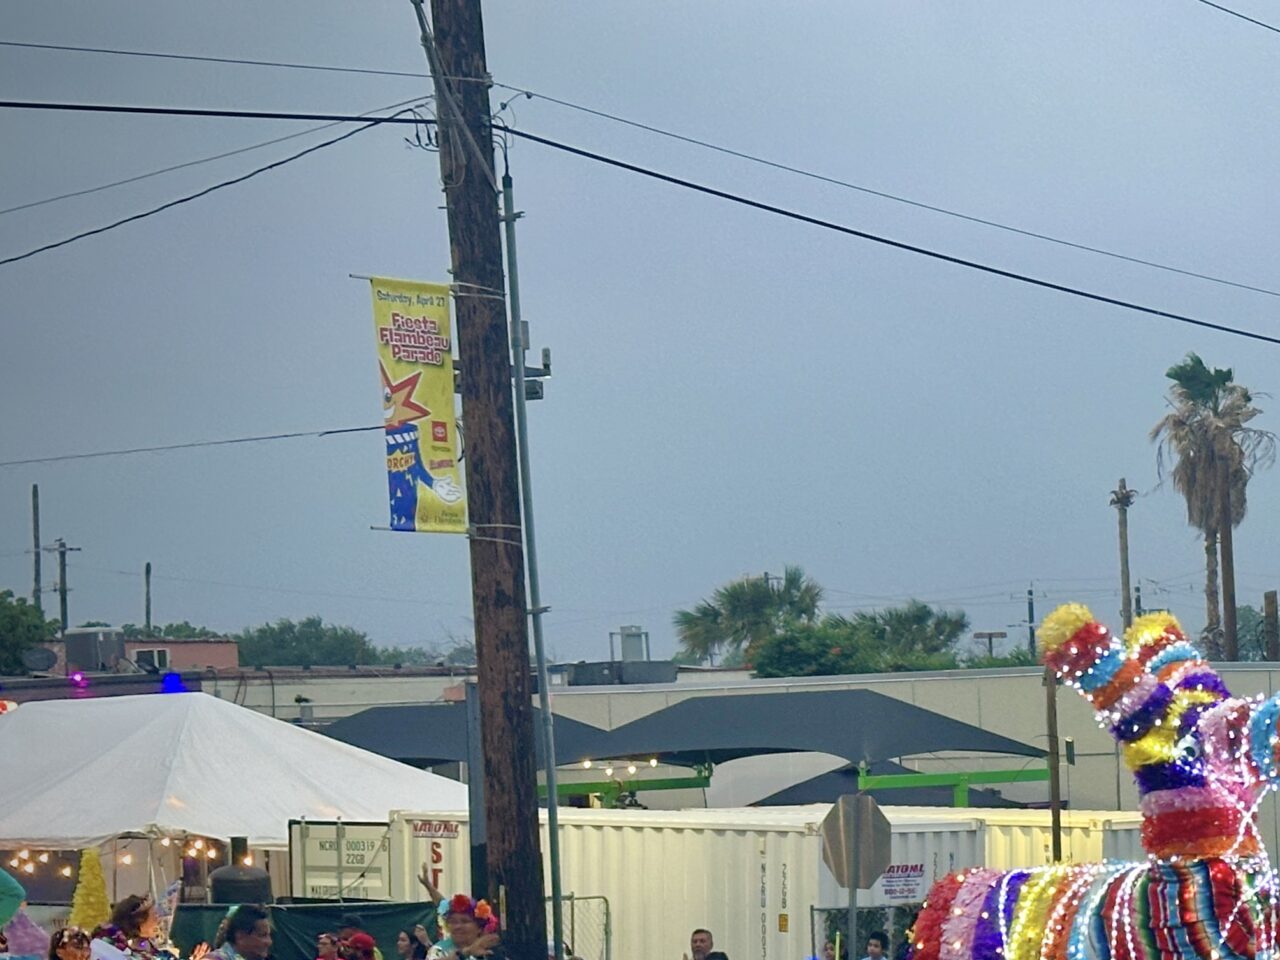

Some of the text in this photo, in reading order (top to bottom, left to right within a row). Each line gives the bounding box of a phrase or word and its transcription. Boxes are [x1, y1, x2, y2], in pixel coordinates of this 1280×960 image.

[416, 294, 434, 307] April
[391, 311, 438, 331] Fiesta
[379, 326, 449, 349] Flambeau
[391, 343, 442, 364] Parade
